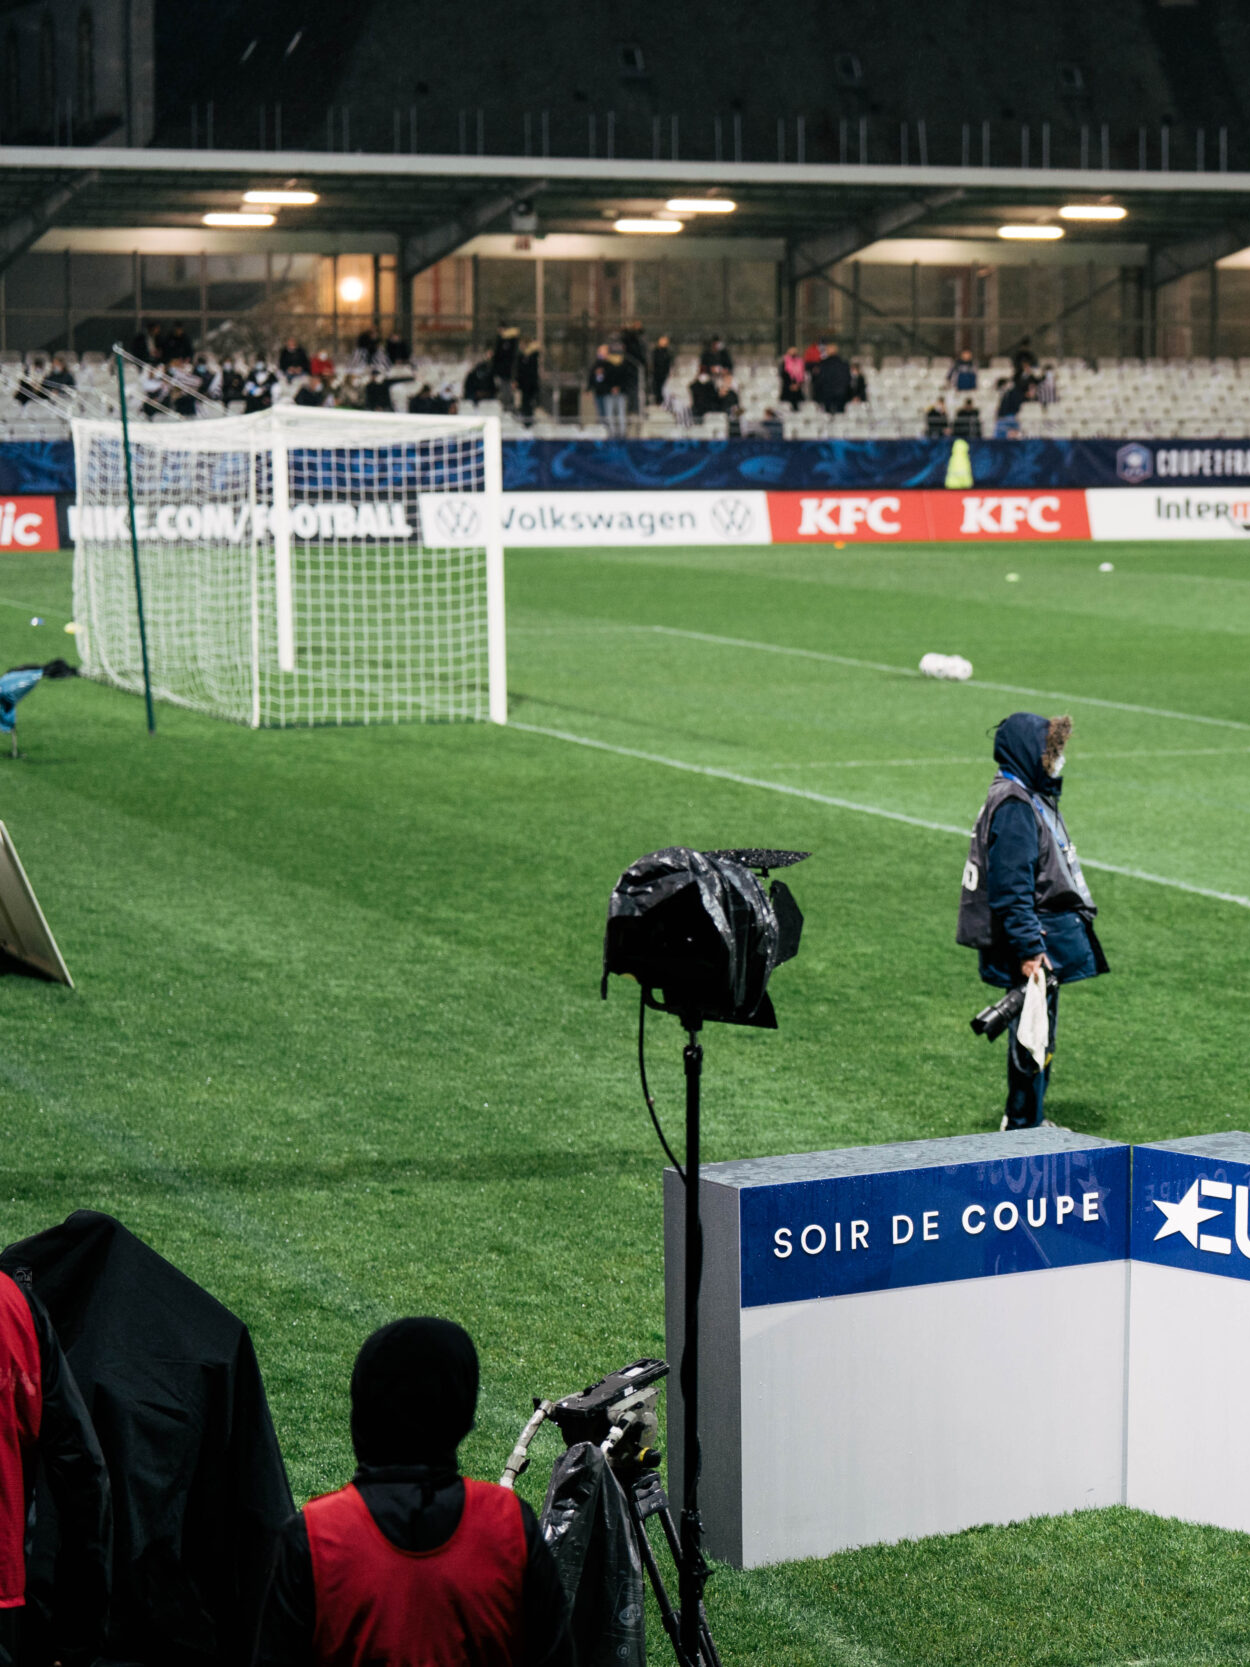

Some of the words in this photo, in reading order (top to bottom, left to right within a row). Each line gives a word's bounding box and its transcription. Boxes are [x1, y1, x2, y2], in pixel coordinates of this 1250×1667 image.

[798, 496, 901, 535] KFC
[960, 495, 1061, 534] KFC
[773, 1219, 870, 1259] SOIR
[892, 1210, 940, 1246] DE
[961, 1191, 1101, 1236] COUPE
